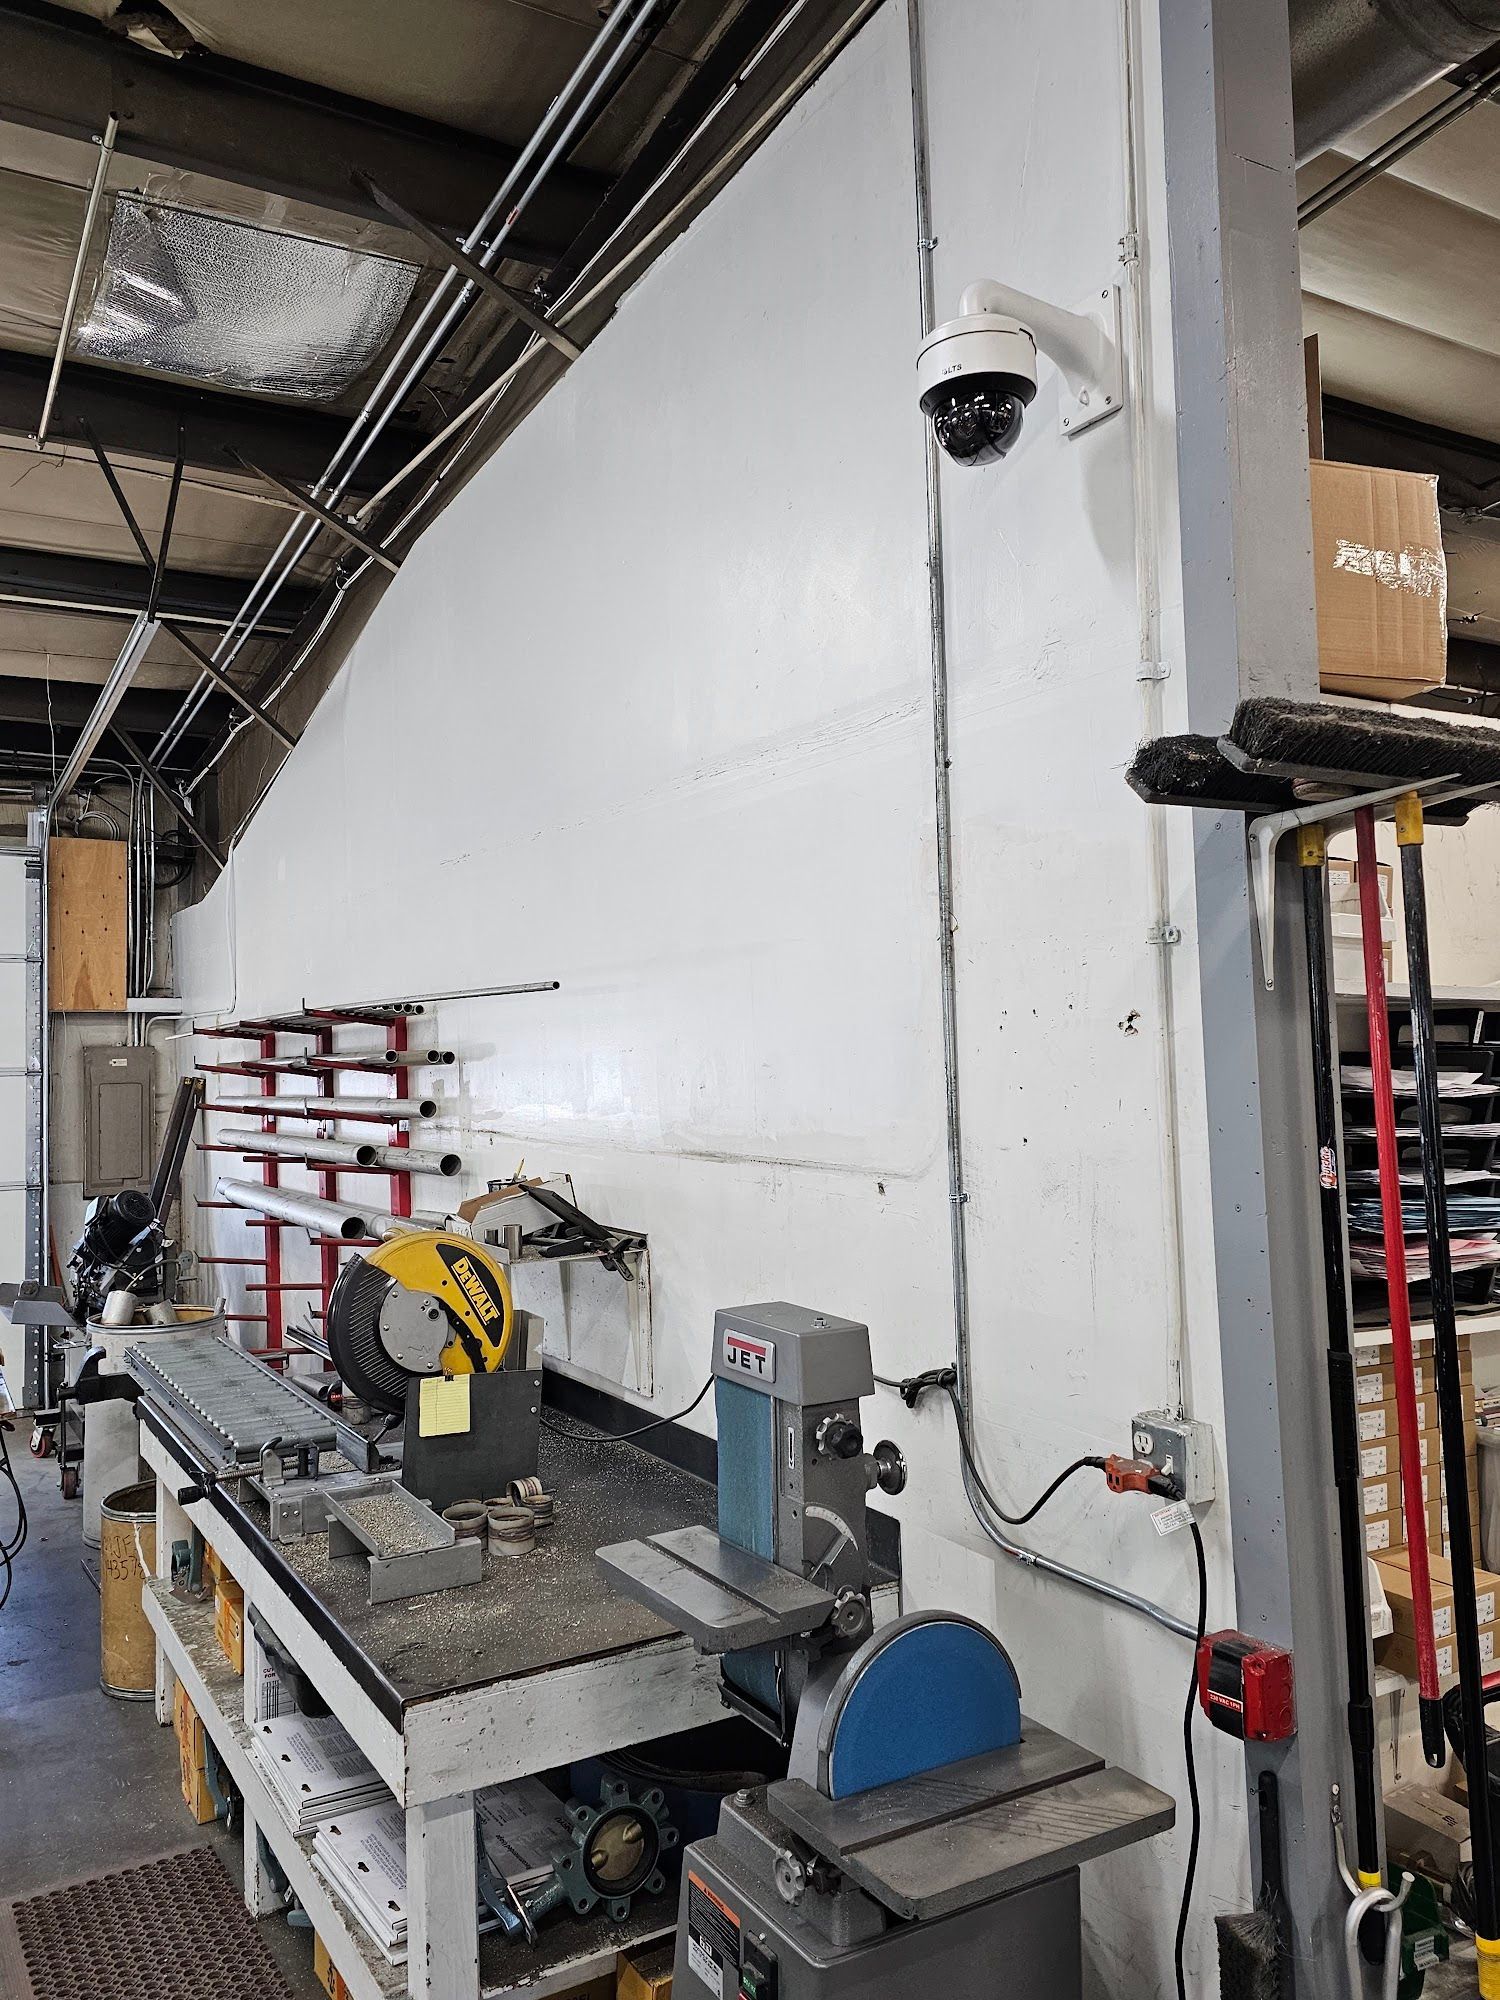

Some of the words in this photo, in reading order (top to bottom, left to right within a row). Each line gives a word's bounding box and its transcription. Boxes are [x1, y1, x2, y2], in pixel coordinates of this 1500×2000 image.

[947, 363, 962, 373] LTS
[453, 1257, 498, 1322] DEWALT
[727, 1347, 766, 1374] JET
